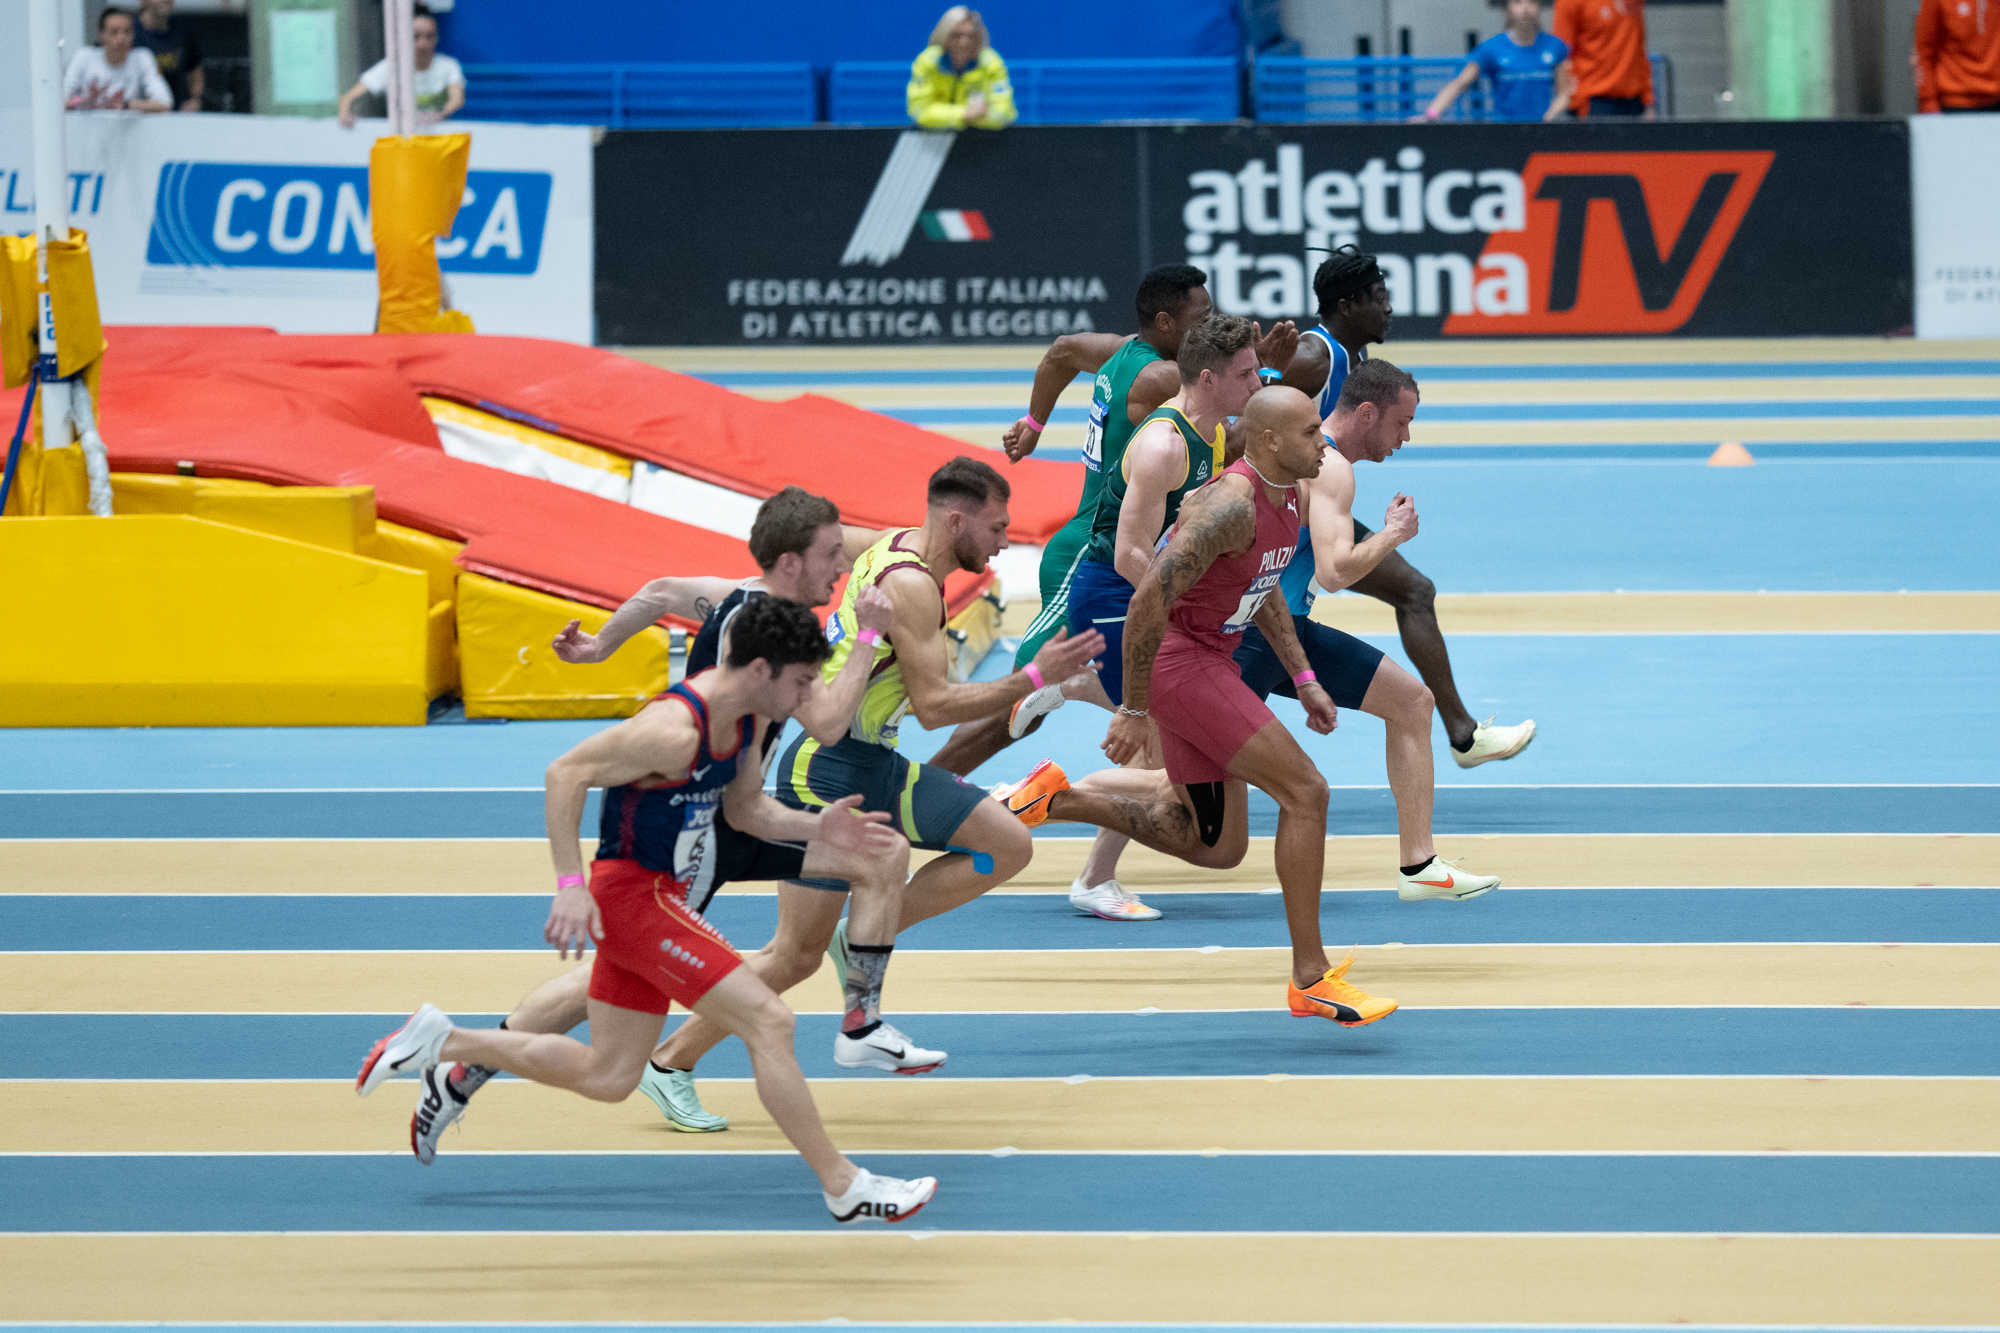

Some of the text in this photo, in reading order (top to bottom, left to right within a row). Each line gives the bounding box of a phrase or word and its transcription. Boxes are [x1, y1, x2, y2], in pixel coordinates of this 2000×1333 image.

[212, 178, 523, 260] CONA
[1183, 143, 1526, 235] atletica
[1185, 230, 1530, 319] italana
[1533, 172, 1741, 314] TV
[727, 276, 1109, 306] FEDERAZIONE ITALIANA
[742, 309, 1095, 339] DI ATLETICA LEGGERA
